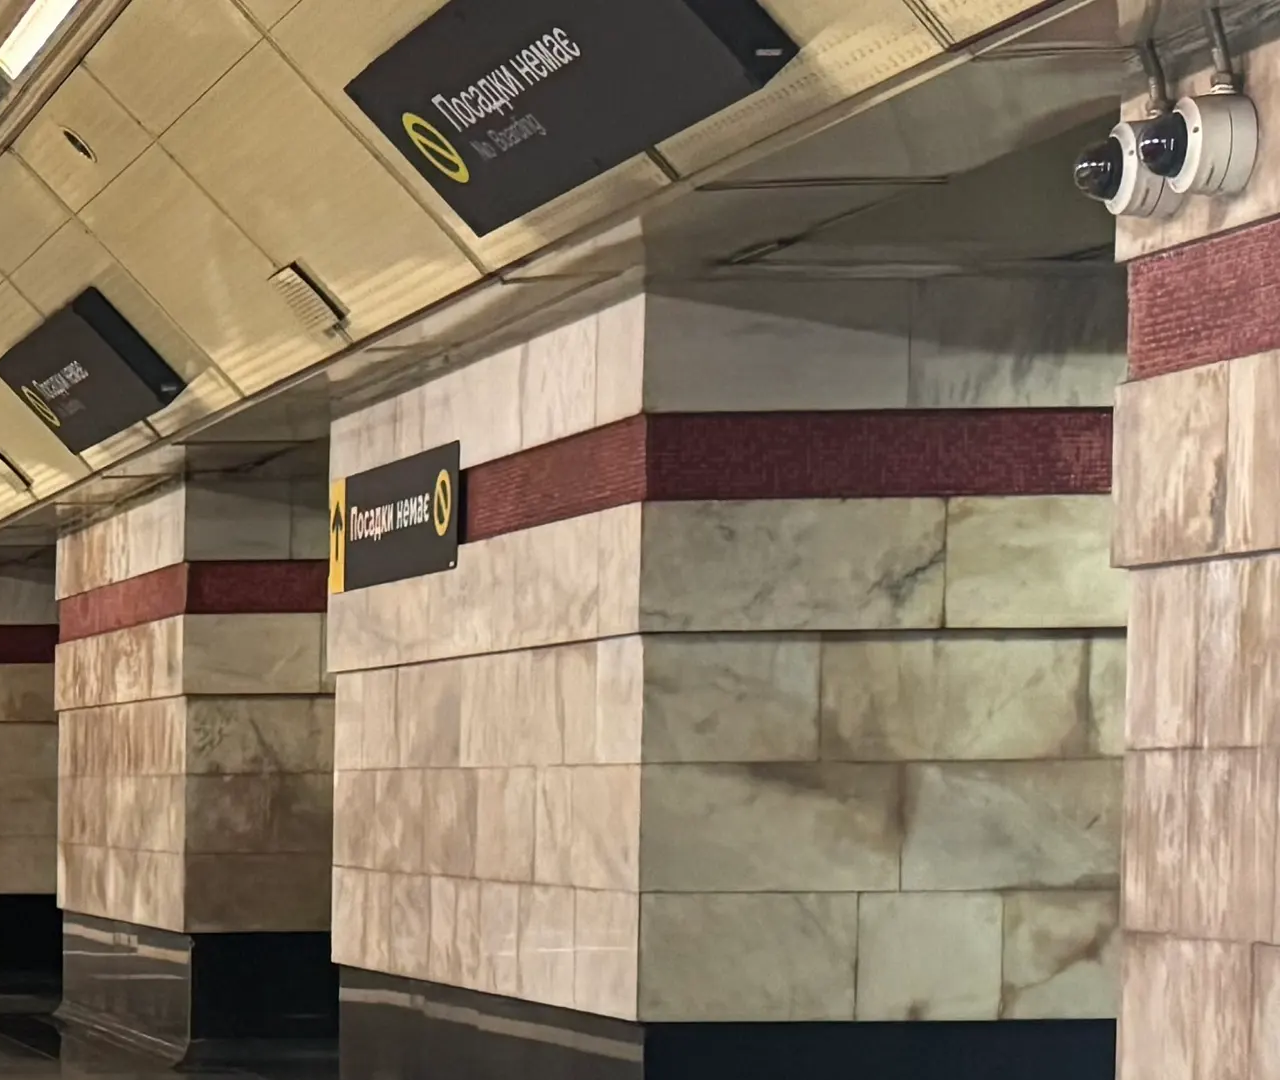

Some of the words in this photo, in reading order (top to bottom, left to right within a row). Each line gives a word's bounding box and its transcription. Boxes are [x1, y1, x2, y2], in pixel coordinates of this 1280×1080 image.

[431, 65, 525, 132] Посадки
[509, 27, 581, 86] немає
[350, 502, 394, 541] Посадки
[396, 493, 430, 530] немає
